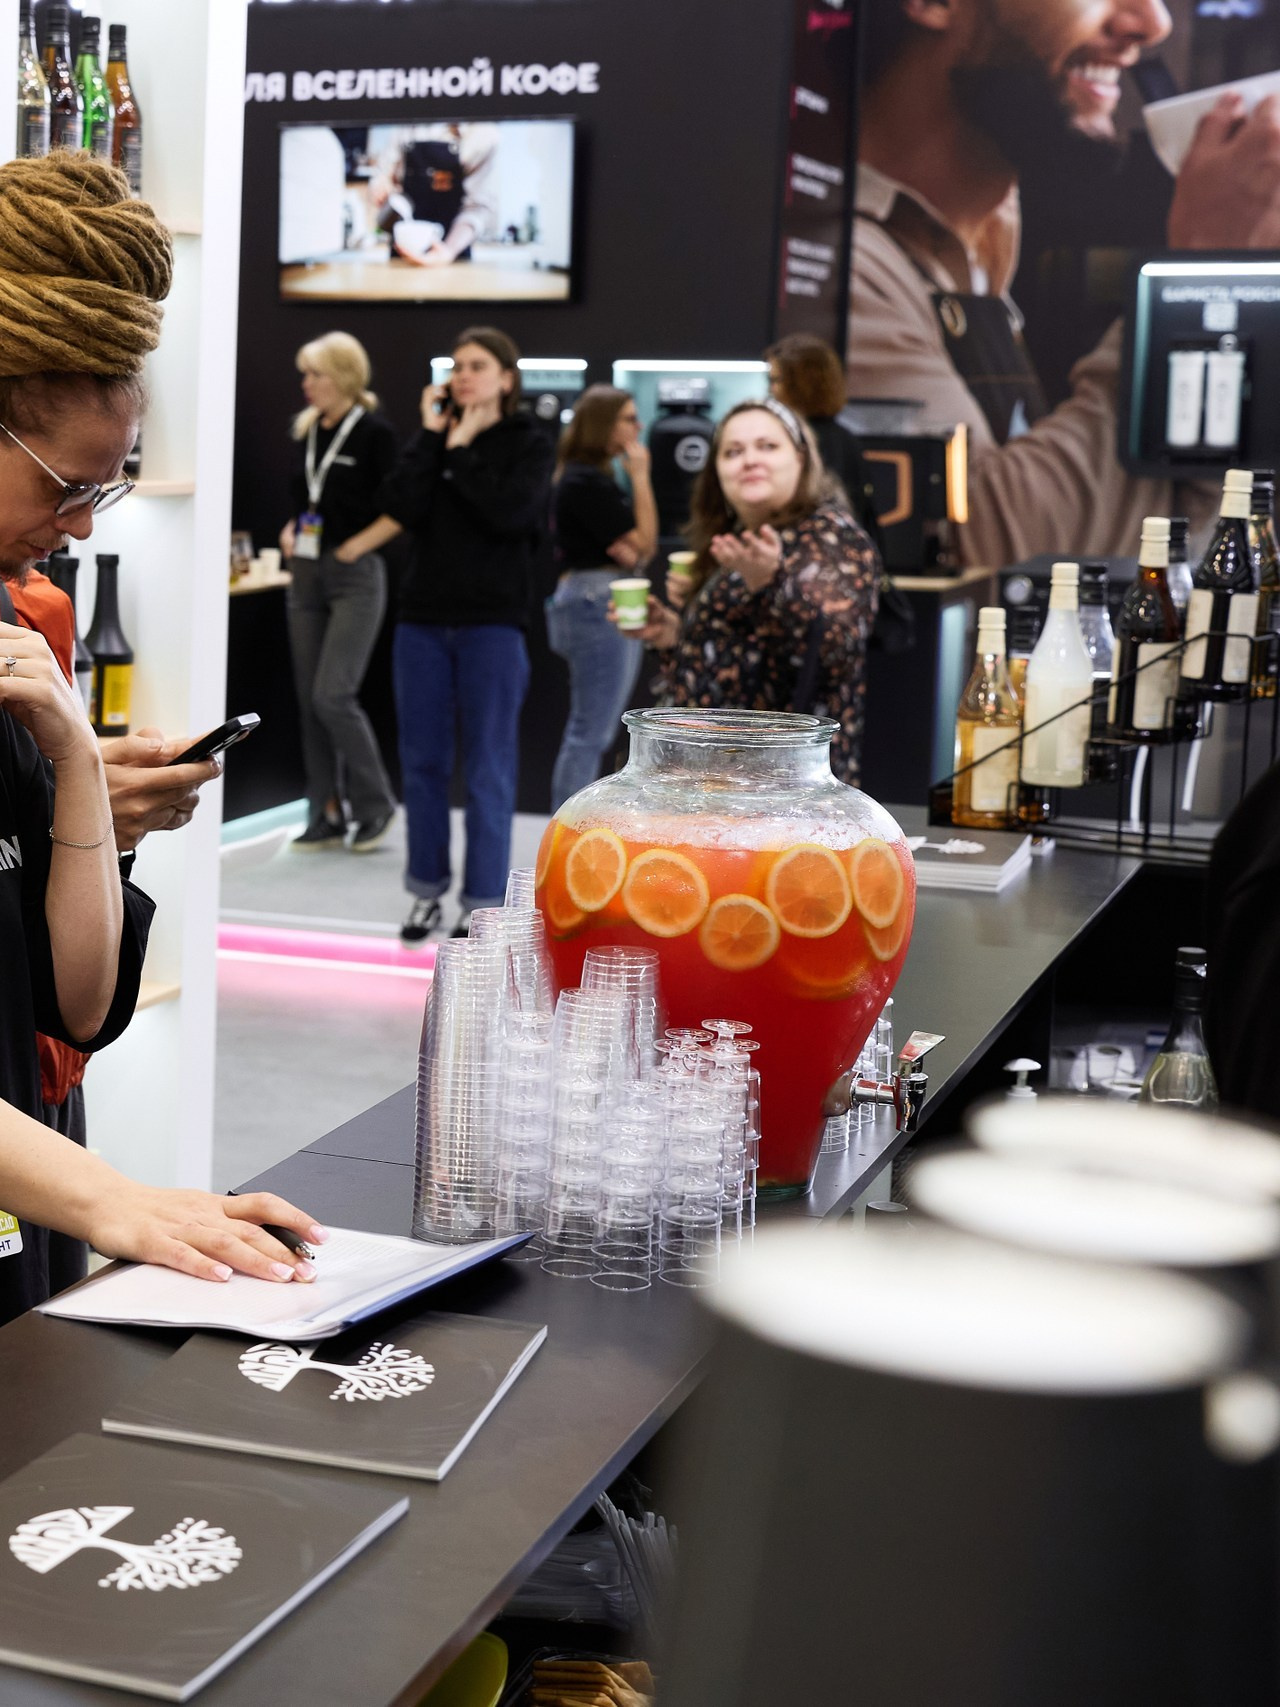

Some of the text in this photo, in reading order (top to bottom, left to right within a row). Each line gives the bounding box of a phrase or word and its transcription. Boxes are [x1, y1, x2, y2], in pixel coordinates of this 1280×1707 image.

[245, 56, 601, 101] ЛЯ ВСЕЛЕННОЙ КОФЕ
